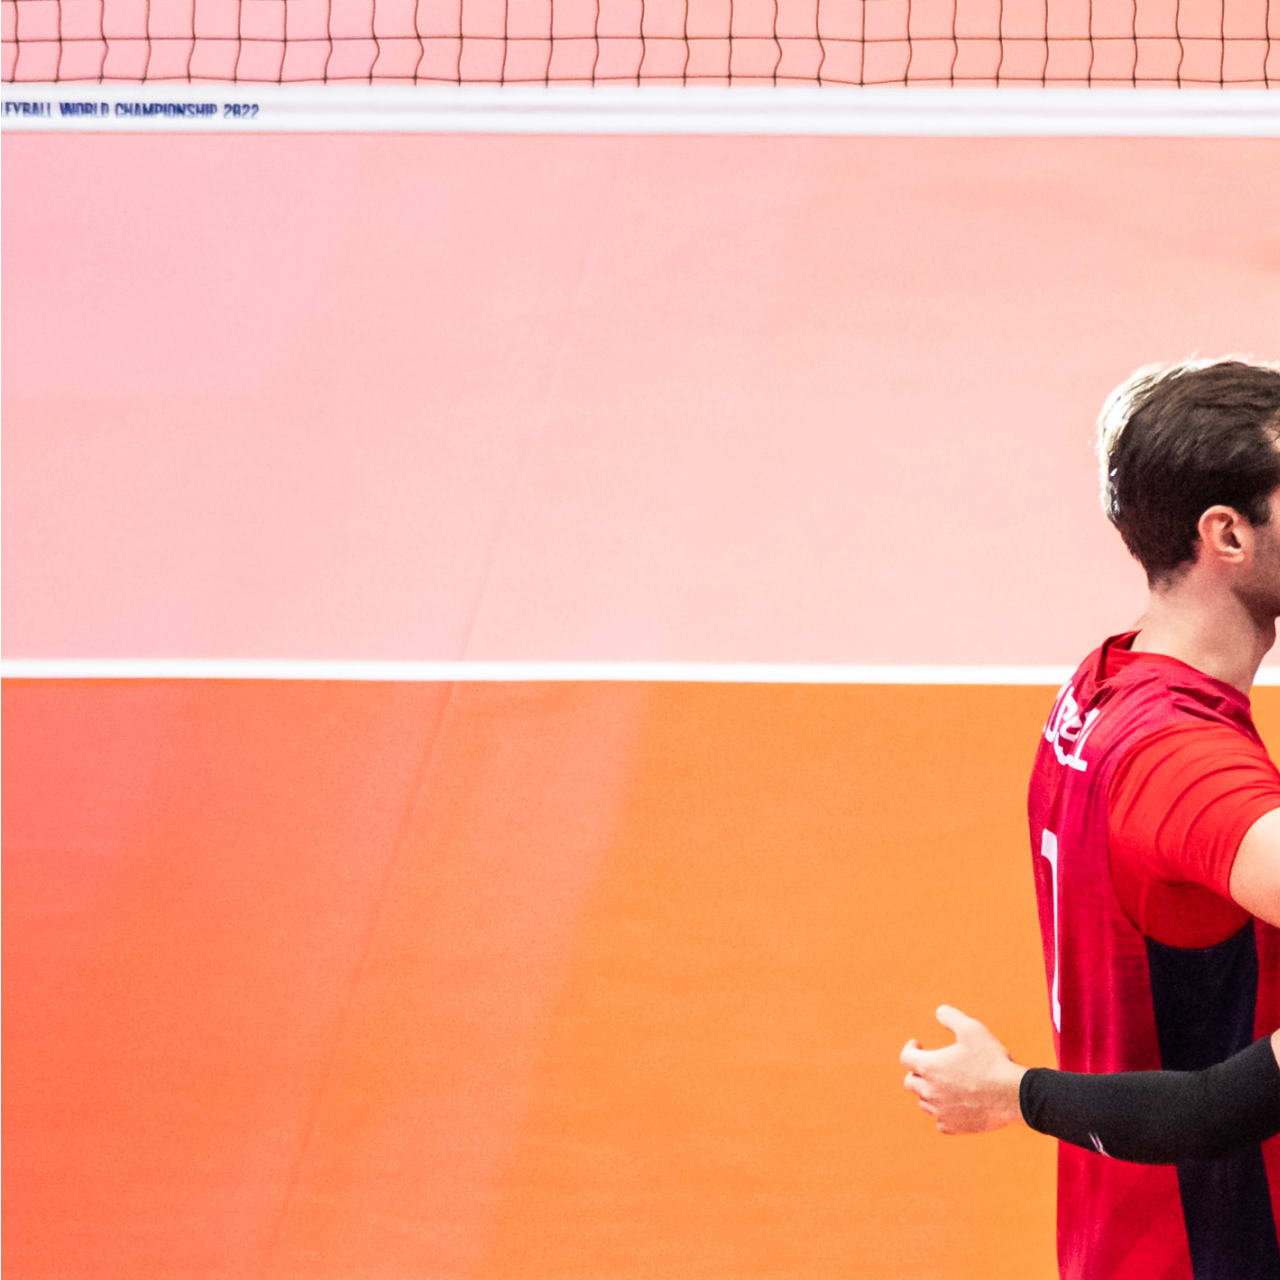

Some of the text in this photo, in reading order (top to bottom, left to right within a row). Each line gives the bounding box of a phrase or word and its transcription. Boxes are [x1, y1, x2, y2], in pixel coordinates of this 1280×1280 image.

[59, 101, 110, 118] WORLD
[115, 102, 218, 119] CHAMPIONSHIP
[222, 103, 260, 119] 2022
